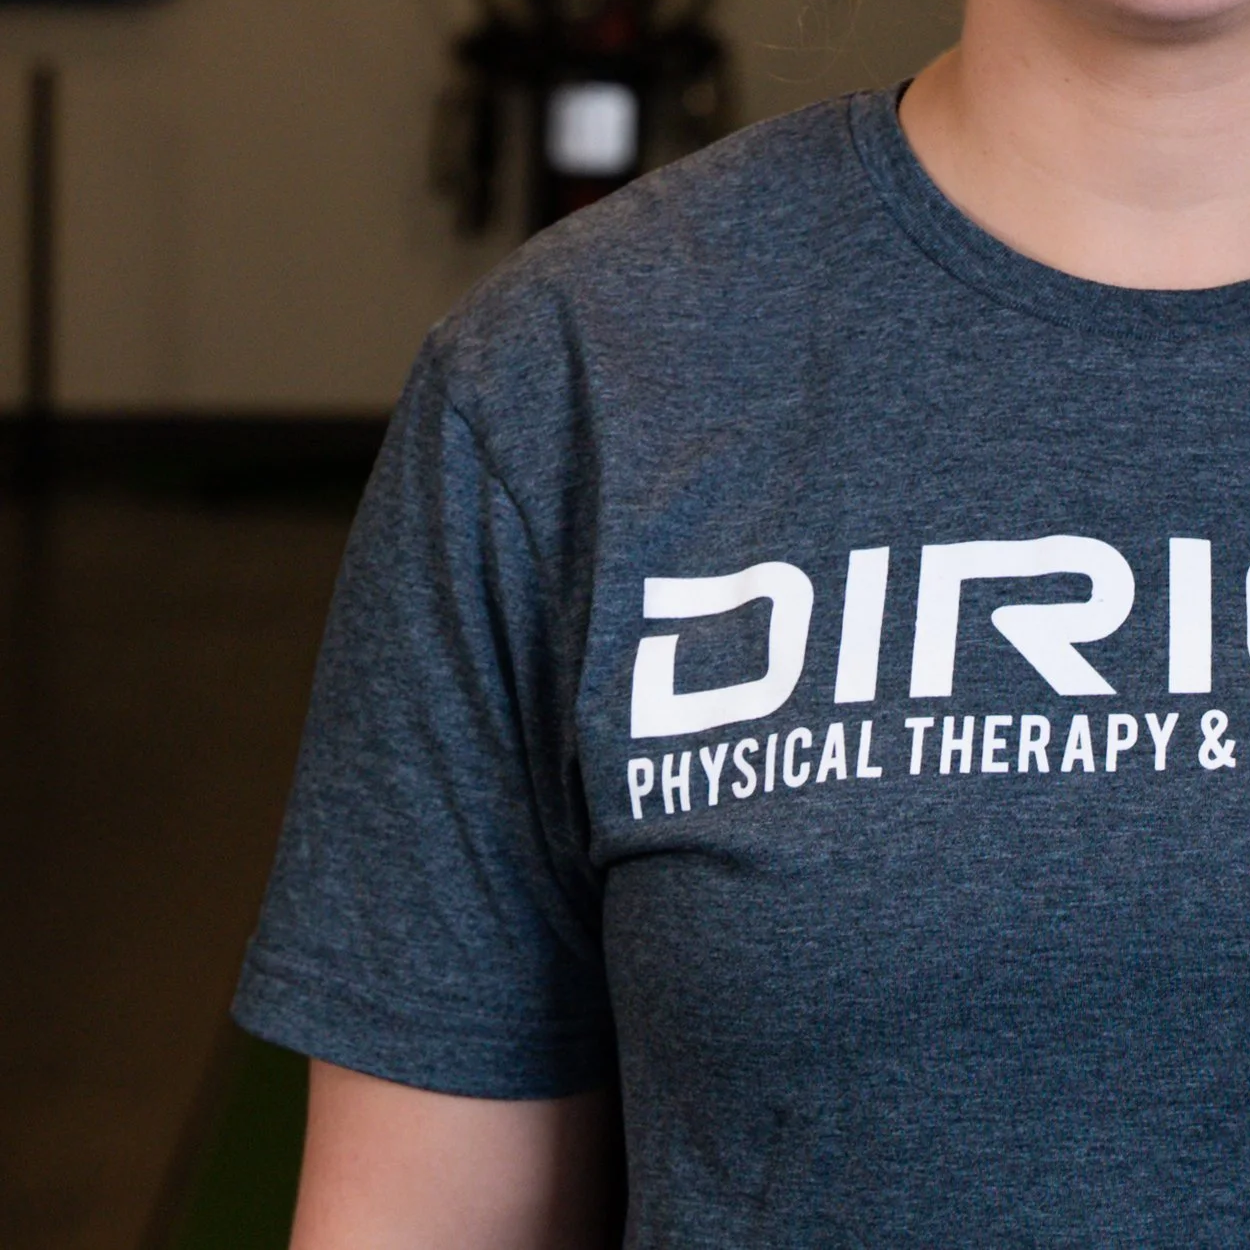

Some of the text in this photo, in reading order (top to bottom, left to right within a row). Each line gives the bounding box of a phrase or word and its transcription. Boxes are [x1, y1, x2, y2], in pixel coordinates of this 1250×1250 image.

[627, 720, 882, 820] PHYSICAL
[904, 712, 1180, 776] THERAPY
[1197, 709, 1237, 771] &
